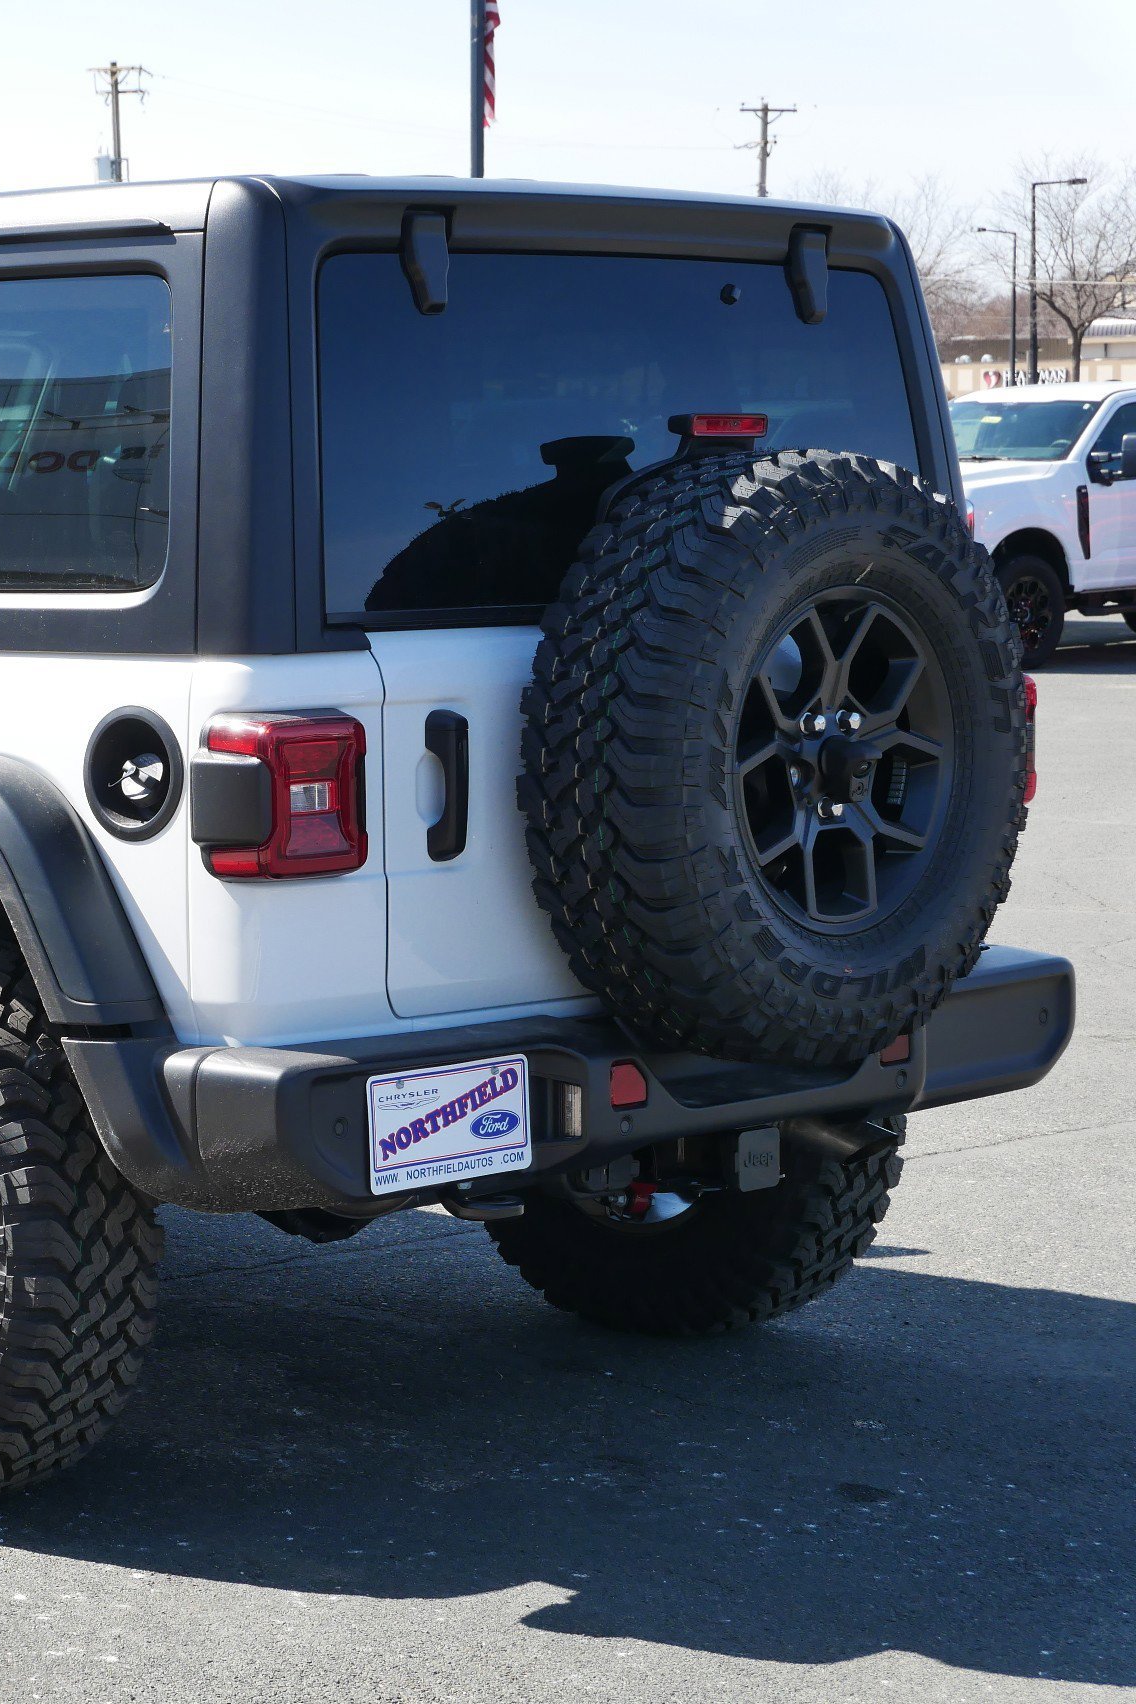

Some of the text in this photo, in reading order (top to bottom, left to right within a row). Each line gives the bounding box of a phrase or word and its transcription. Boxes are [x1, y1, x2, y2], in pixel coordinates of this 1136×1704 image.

[378, 1088, 440, 1103] CHRYSLER
[378, 1067, 520, 1162] NORTHFIELD
[479, 1114, 510, 1135] Ford
[406, 1156, 494, 1181] NORTHFIELDAUTOS
[500, 1151, 525, 1165] .COM
